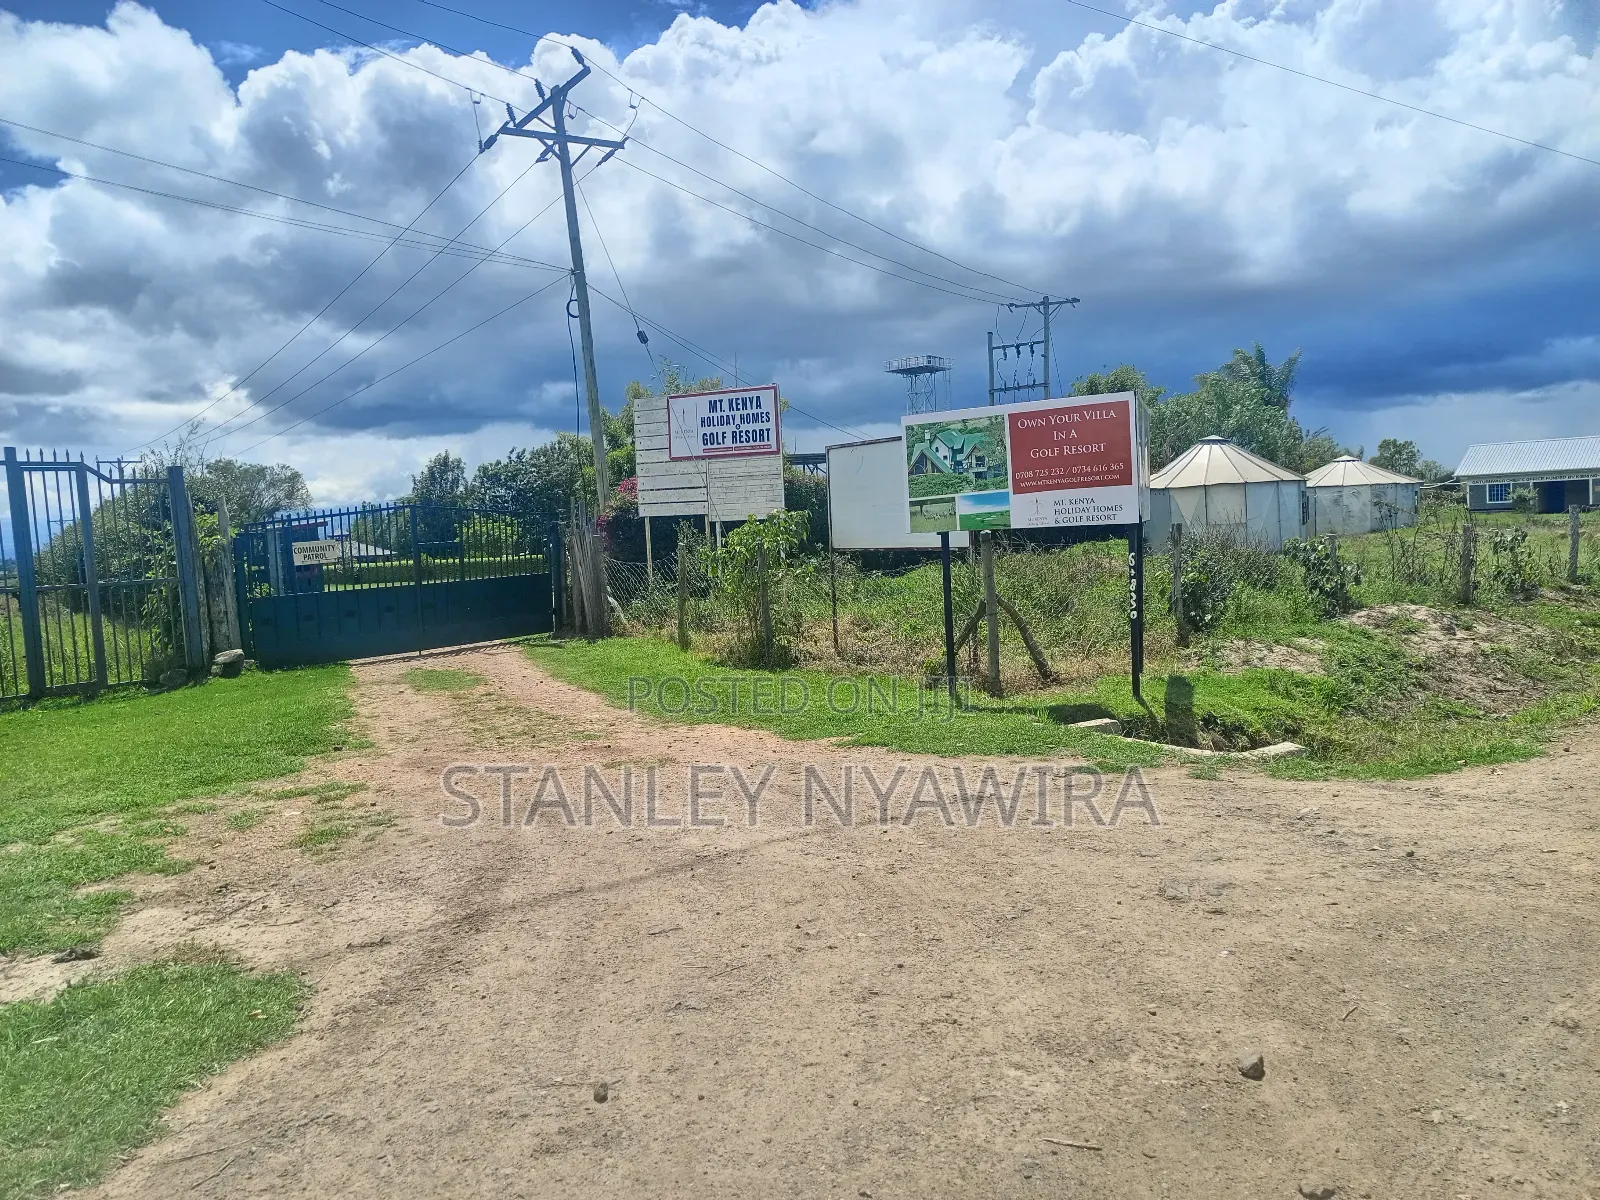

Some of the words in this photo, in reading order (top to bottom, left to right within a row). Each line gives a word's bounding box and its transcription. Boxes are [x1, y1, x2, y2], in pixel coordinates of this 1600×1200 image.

[708, 400, 725, 414] MT.
[728, 396, 762, 412] KENYA
[700, 414, 736, 428] HOLIDAY
[740, 412, 770, 424] HOMES
[1018, 418, 1046, 428] OWN
[1048, 413, 1082, 424] YOUR
[1082, 410, 1116, 420] VILLA
[702, 432, 726, 446] GOLF
[732, 428, 770, 444] RESORT
[1053, 430, 1066, 440] IN
[1069, 429, 1078, 438] A
[1030, 448, 1060, 458] GOLF
[1063, 443, 1106, 456] RESORT
[1016, 470, 1034, 480] 0708
[1035, 468, 1048, 478] 725
[1050, 468, 1064, 476] 232
[1066, 466, 1070, 474] /
[1072, 464, 1091, 474] 0734
[1093, 464, 1108, 472] 616
[1110, 462, 1124, 471] 365
[1069, 498, 1096, 506] KENYA
[1054, 506, 1091, 516] HOLIDAY
[1093, 504, 1123, 513] HOMES
[1062, 516, 1084, 524] GOLF
[1086, 514, 1117, 522] RESORT
[294, 544, 336, 554] COMMUNITY
[304, 552, 327, 560] PATROL
